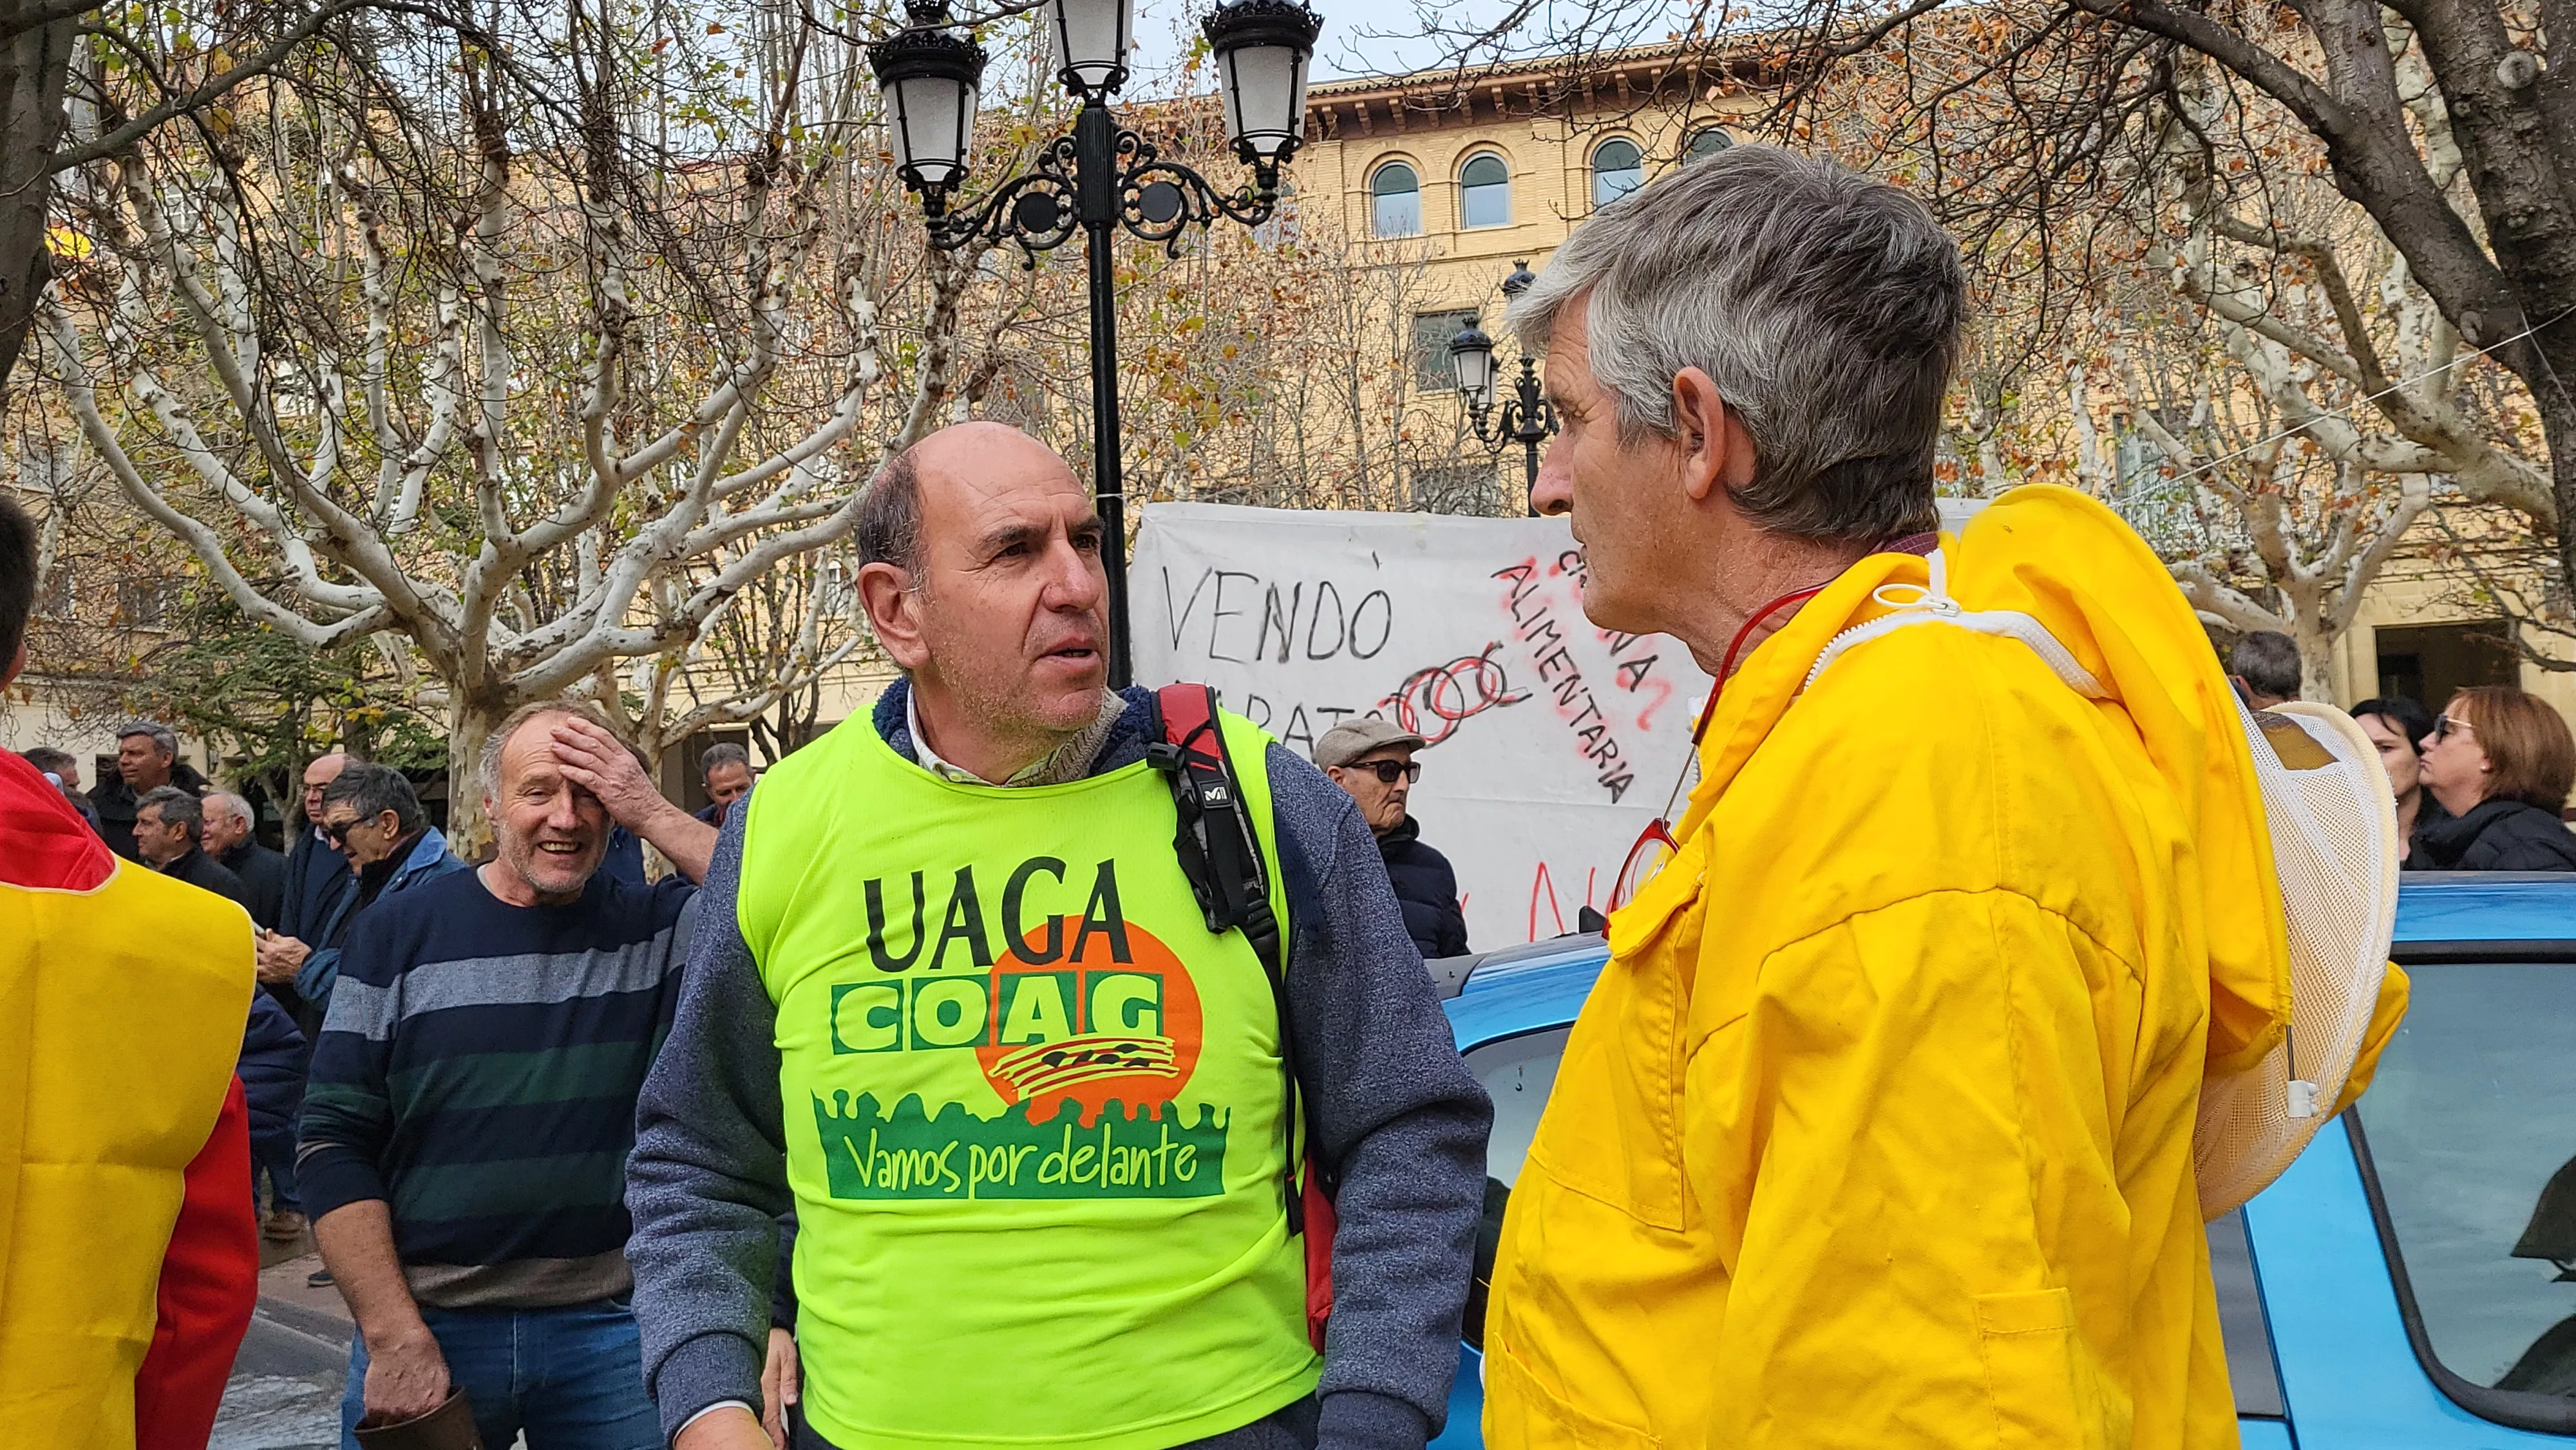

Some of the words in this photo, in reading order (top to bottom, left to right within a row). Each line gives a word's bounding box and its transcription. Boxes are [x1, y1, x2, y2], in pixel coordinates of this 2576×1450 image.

[1490, 565, 1634, 804] ALIMENTARIA
[863, 856, 1133, 972] UAGA
[837, 974, 1158, 1050] COAG
[844, 1128, 961, 1192] Vamos
[969, 1142, 1037, 1199] por
[1038, 1123, 1197, 1189] delante
